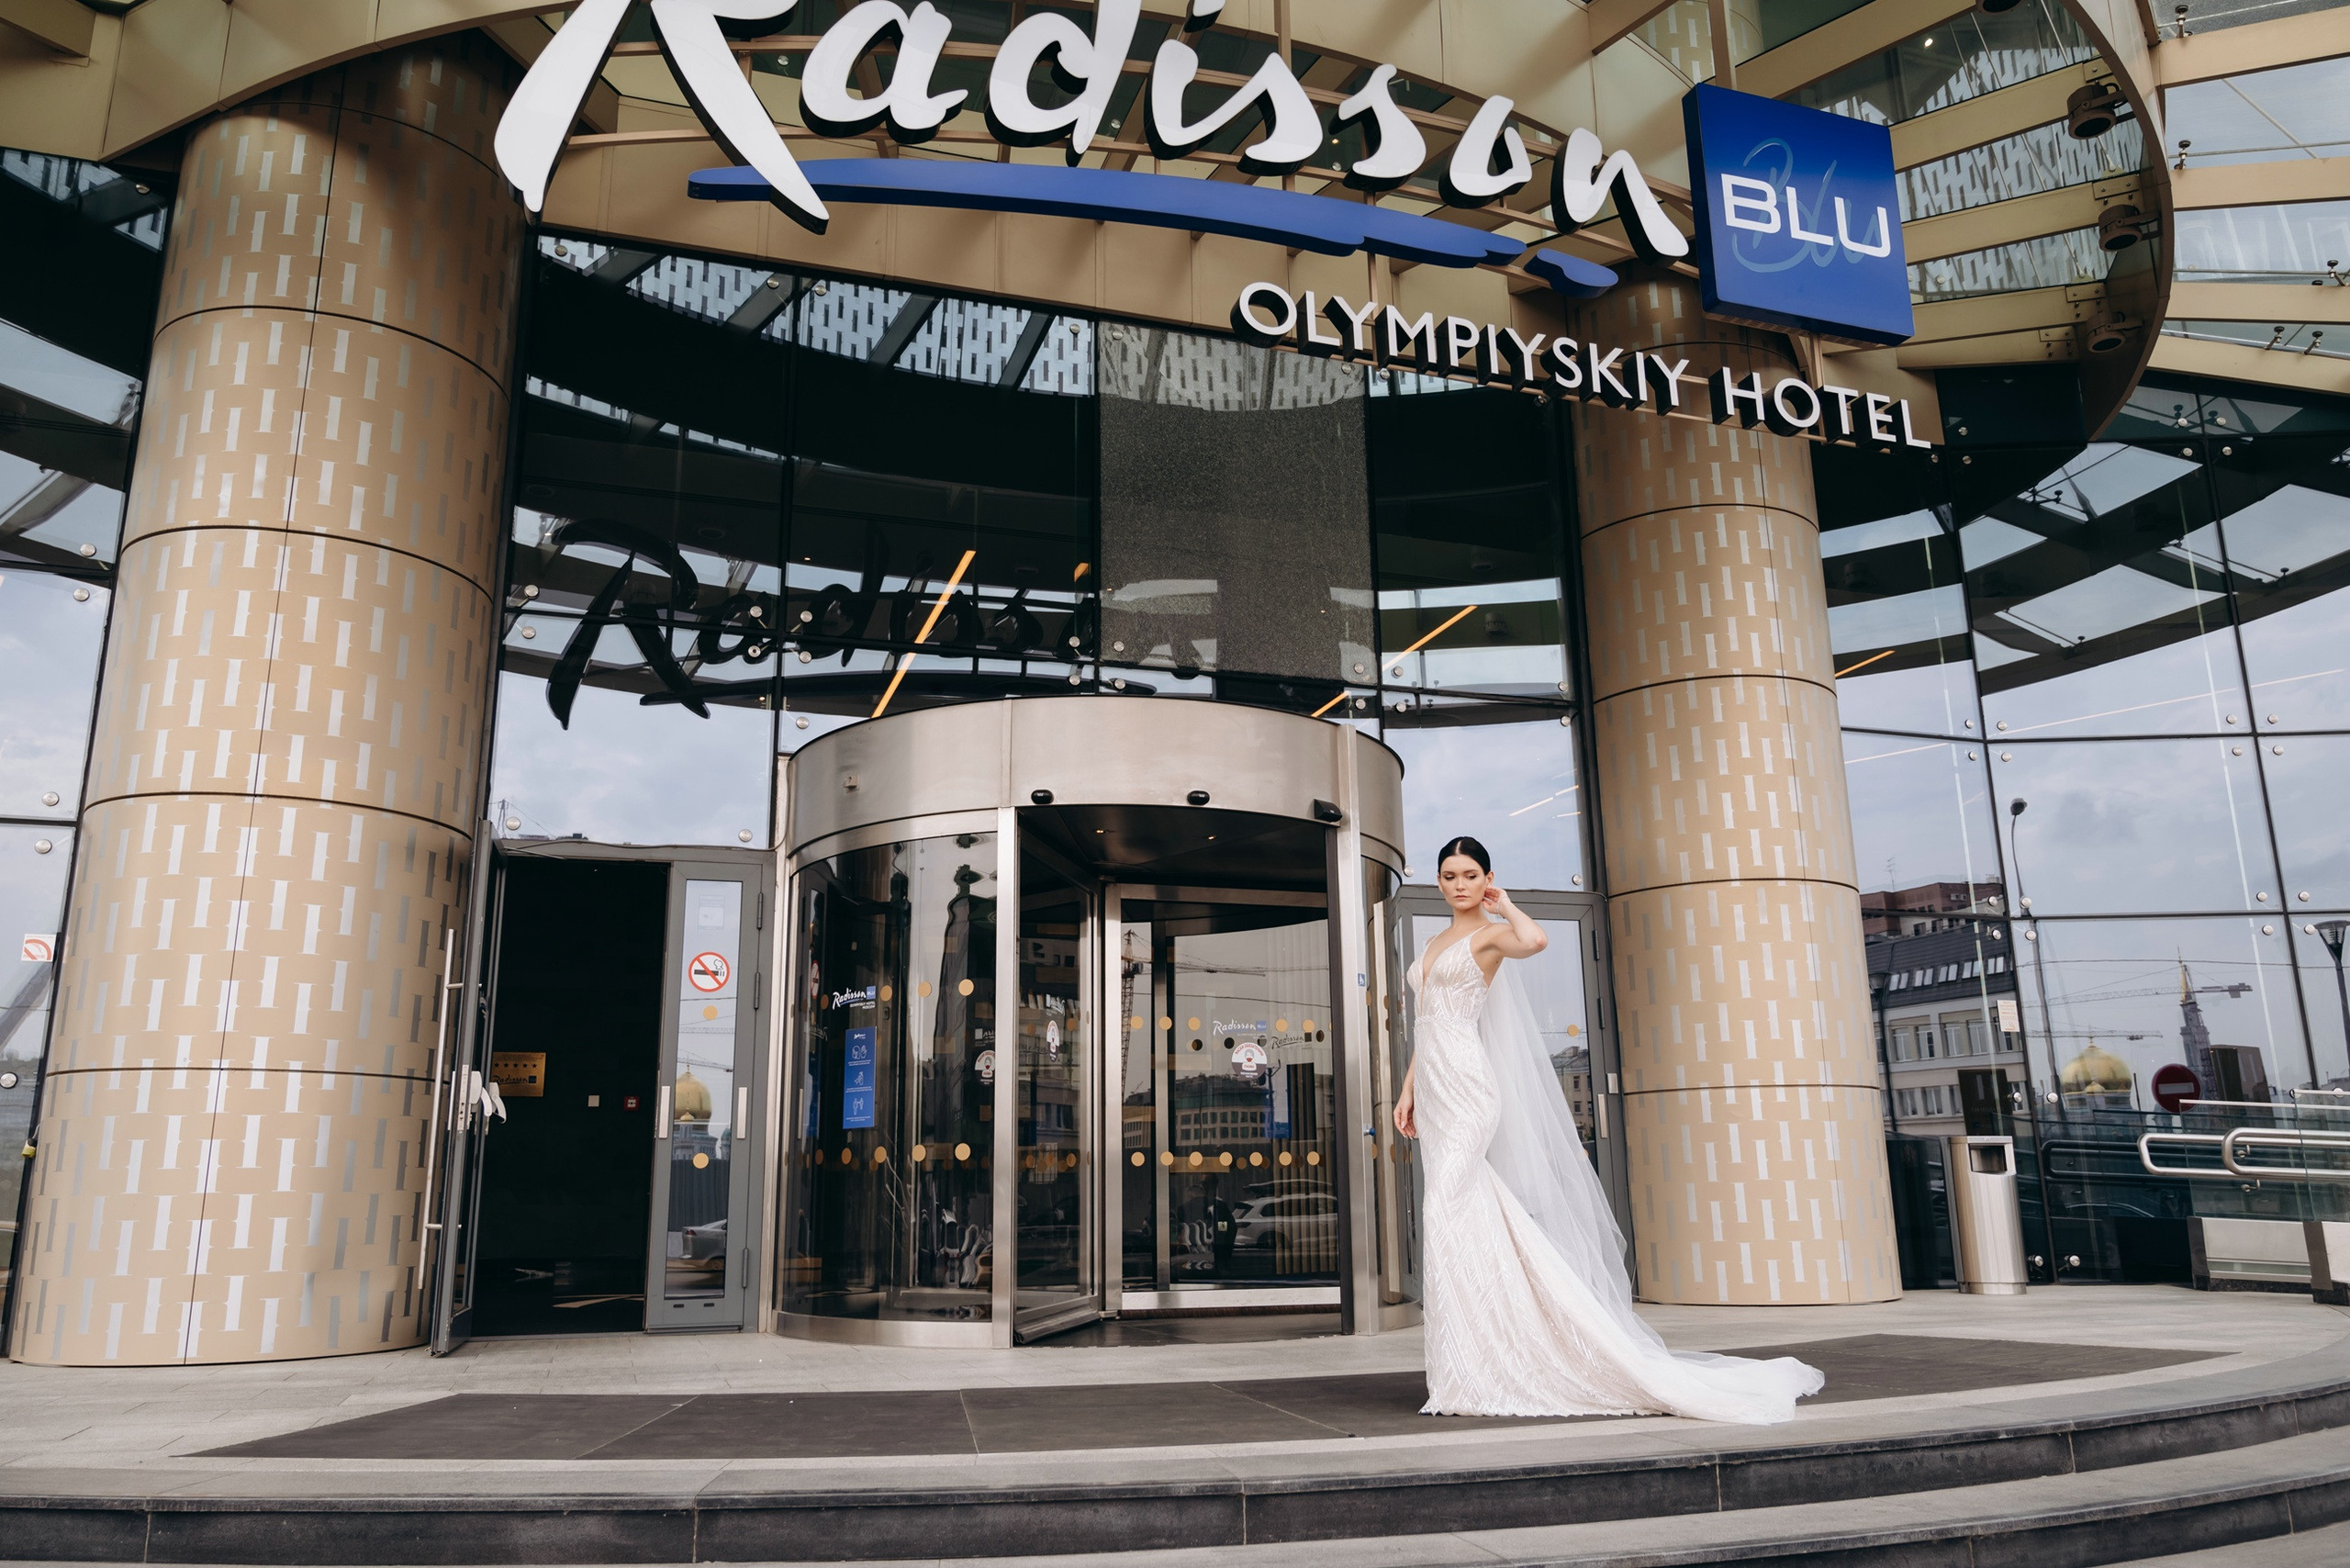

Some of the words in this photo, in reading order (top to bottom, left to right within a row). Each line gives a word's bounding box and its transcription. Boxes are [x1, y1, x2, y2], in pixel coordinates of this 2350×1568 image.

[494, 0, 1688, 259] Radisson
[1720, 173, 1891, 258] BLU
[1237, 281, 1690, 407] OLYMPIYSKIY
[1720, 366, 1932, 450] HOTEL
[832, 987, 867, 1011] Radisson
[1212, 1018, 1257, 1036] Radisson
[1270, 1033, 1304, 1049] Radisson
